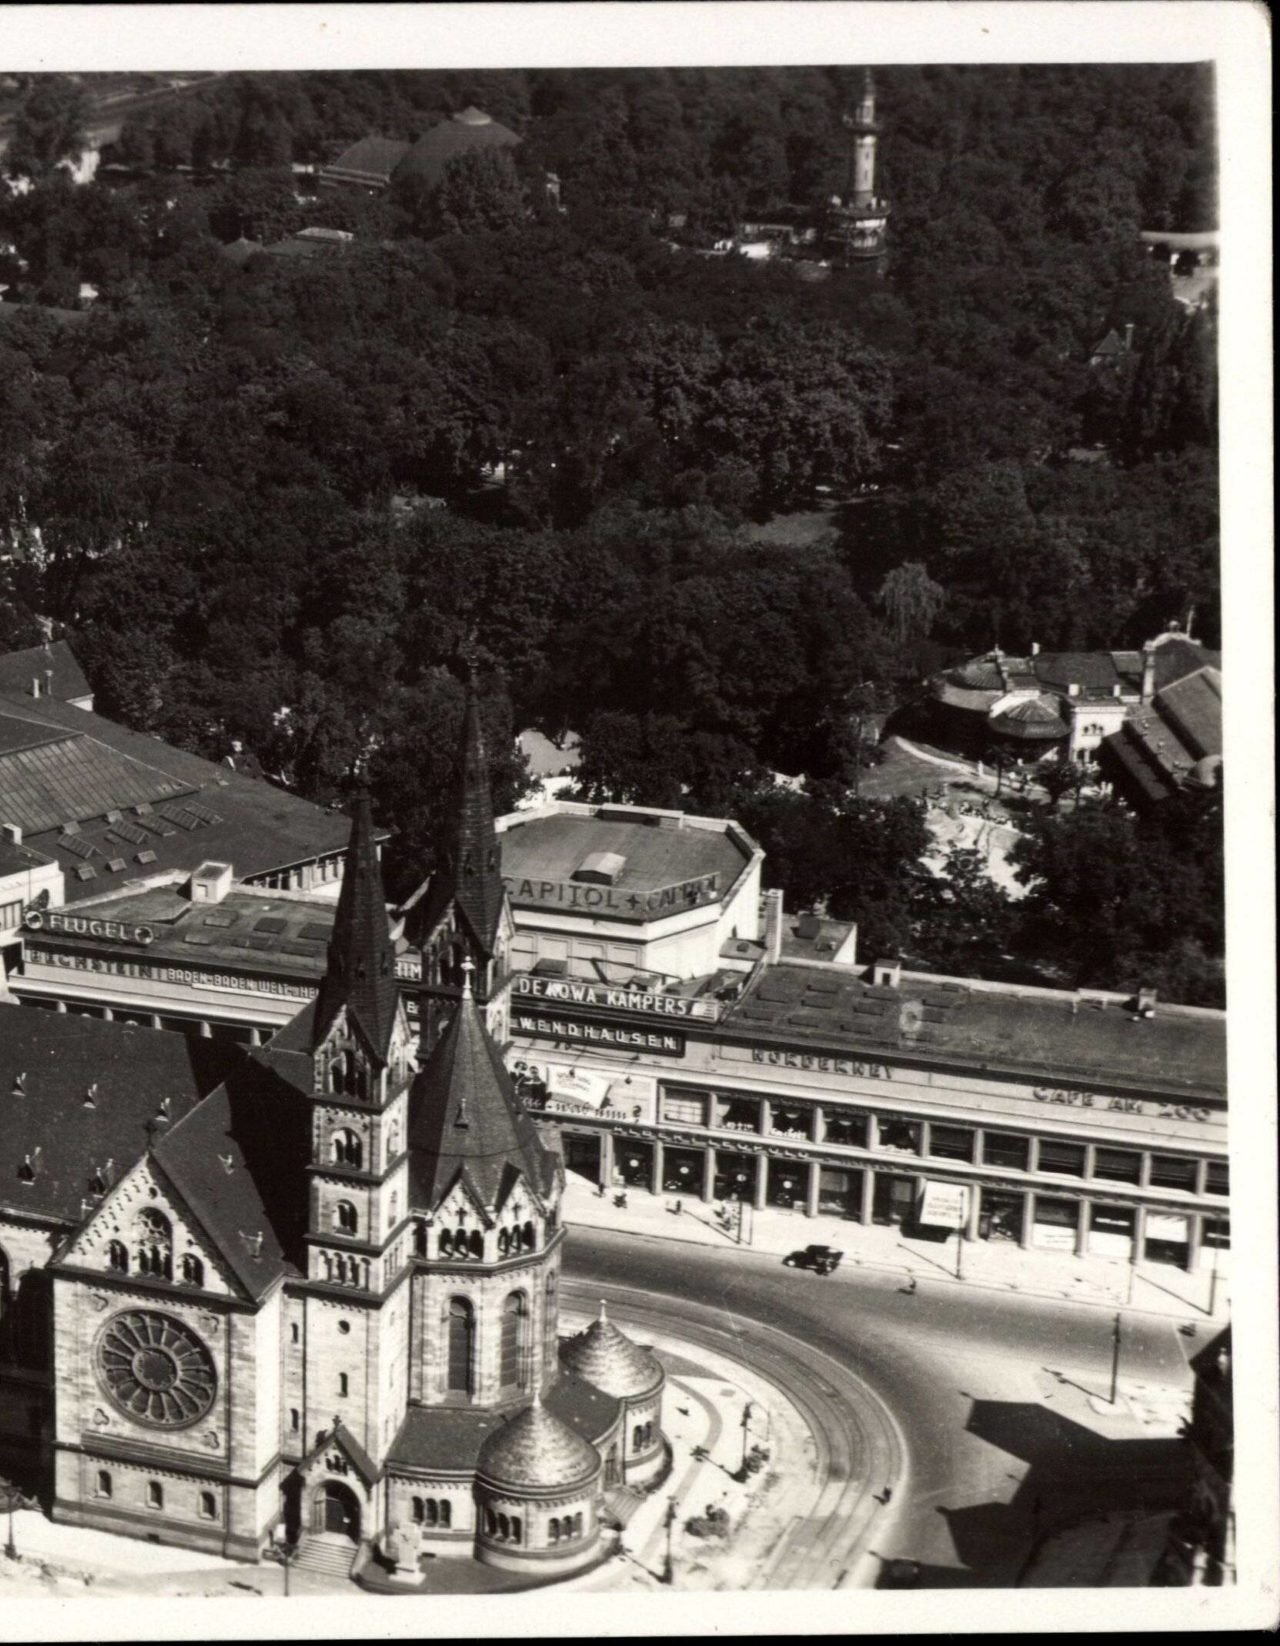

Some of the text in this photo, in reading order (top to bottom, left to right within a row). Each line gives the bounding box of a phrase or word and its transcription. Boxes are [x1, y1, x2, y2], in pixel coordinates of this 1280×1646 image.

[606, 990, 687, 1015] KAMPERS
[519, 1017, 677, 1049] WENDHAUSEN
[1158, 1102, 1211, 1122] ZOO
